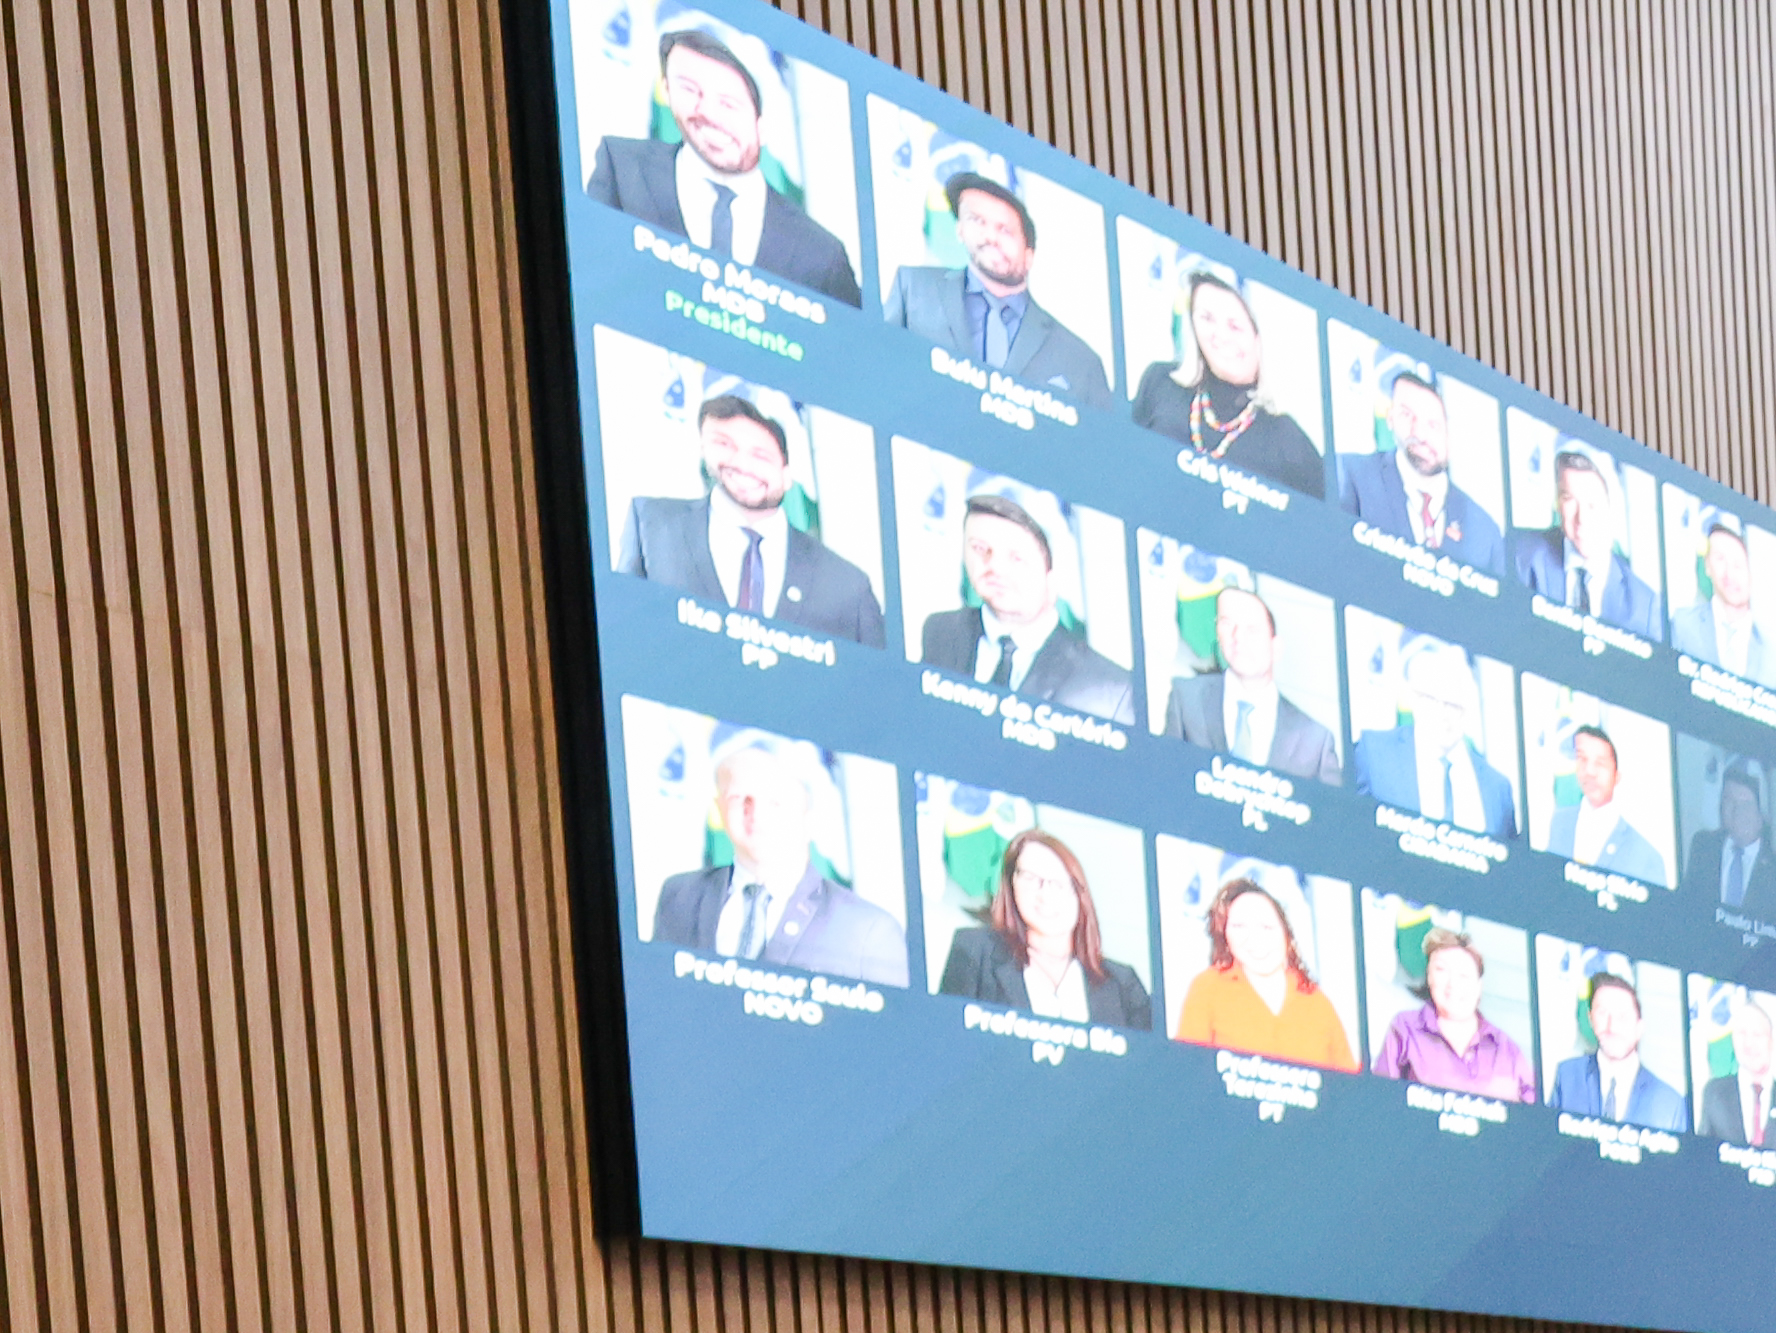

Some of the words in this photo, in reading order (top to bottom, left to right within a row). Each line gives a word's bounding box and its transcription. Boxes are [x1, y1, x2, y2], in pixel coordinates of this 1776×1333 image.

[634, 225, 720, 281] Pedro
[724, 262, 826, 324] Moraes
[665, 290, 804, 361] Presidente
[989, 370, 1079, 426] Martins
[677, 597, 722, 633] Ike
[725, 612, 837, 667] Silvestri
[741, 642, 779, 670] PP
[674, 949, 810, 1001] Professor
[809, 975, 885, 1014] Saulo
[743, 991, 825, 1027] NOVO
[963, 1004, 1089, 1049] Professora
